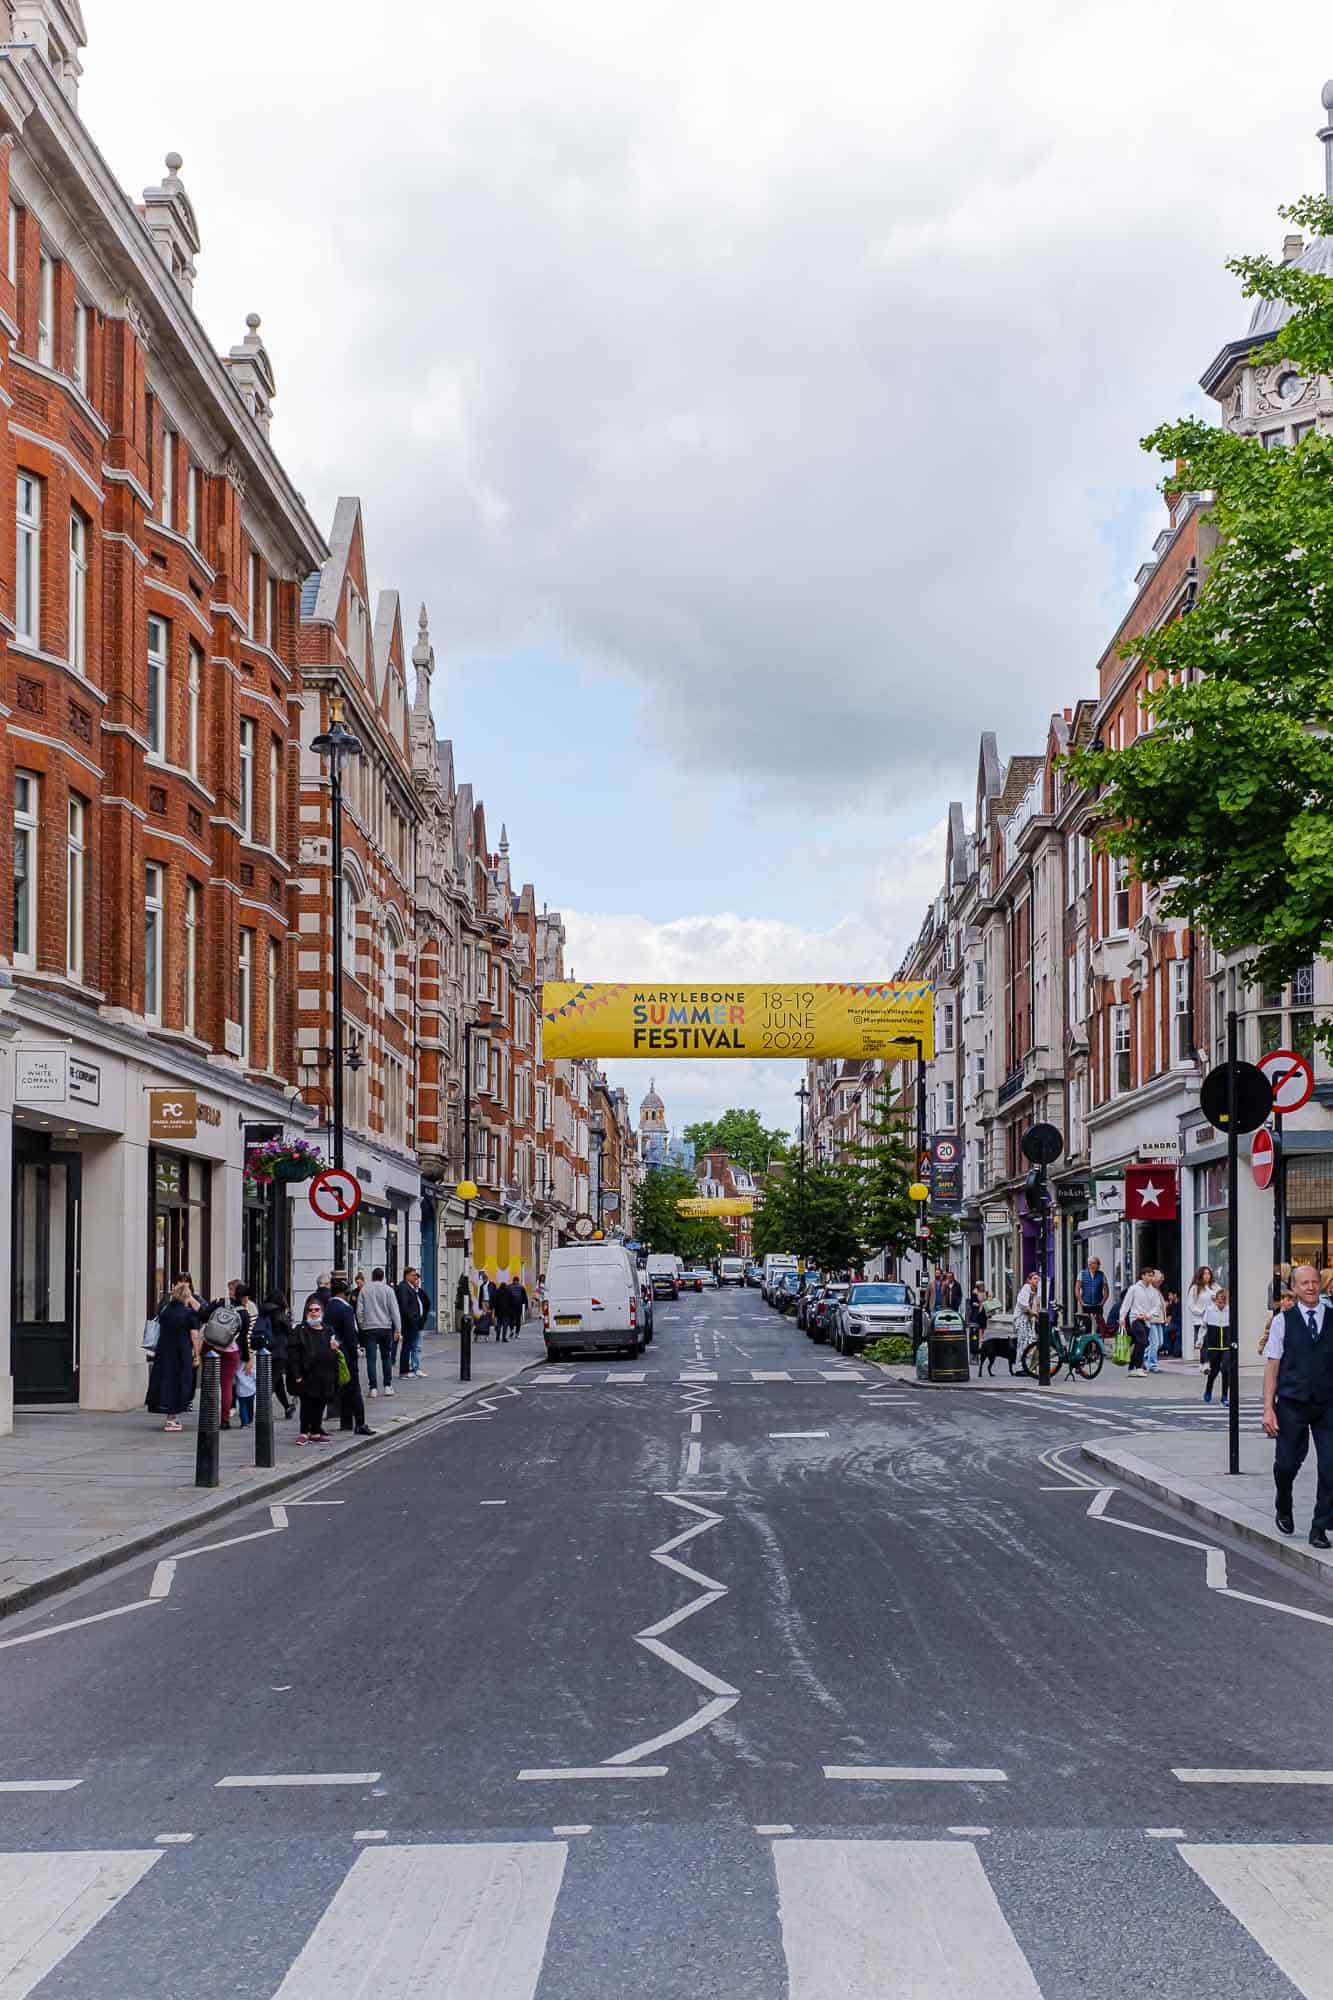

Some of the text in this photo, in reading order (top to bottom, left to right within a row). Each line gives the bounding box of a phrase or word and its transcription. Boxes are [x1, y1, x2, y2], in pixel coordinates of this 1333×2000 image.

[633, 992, 745, 1003] MARYLEBONE
[761, 992, 815, 1010] 18-19
[633, 1004, 745, 1025] SUMMER
[761, 1012, 816, 1030] JUNE
[633, 1027, 746, 1049] FESTIVAL
[761, 1030, 816, 1049] 2022
[939, 1145, 953, 1157] 20
[1142, 1142, 1177, 1150] SANDRO
